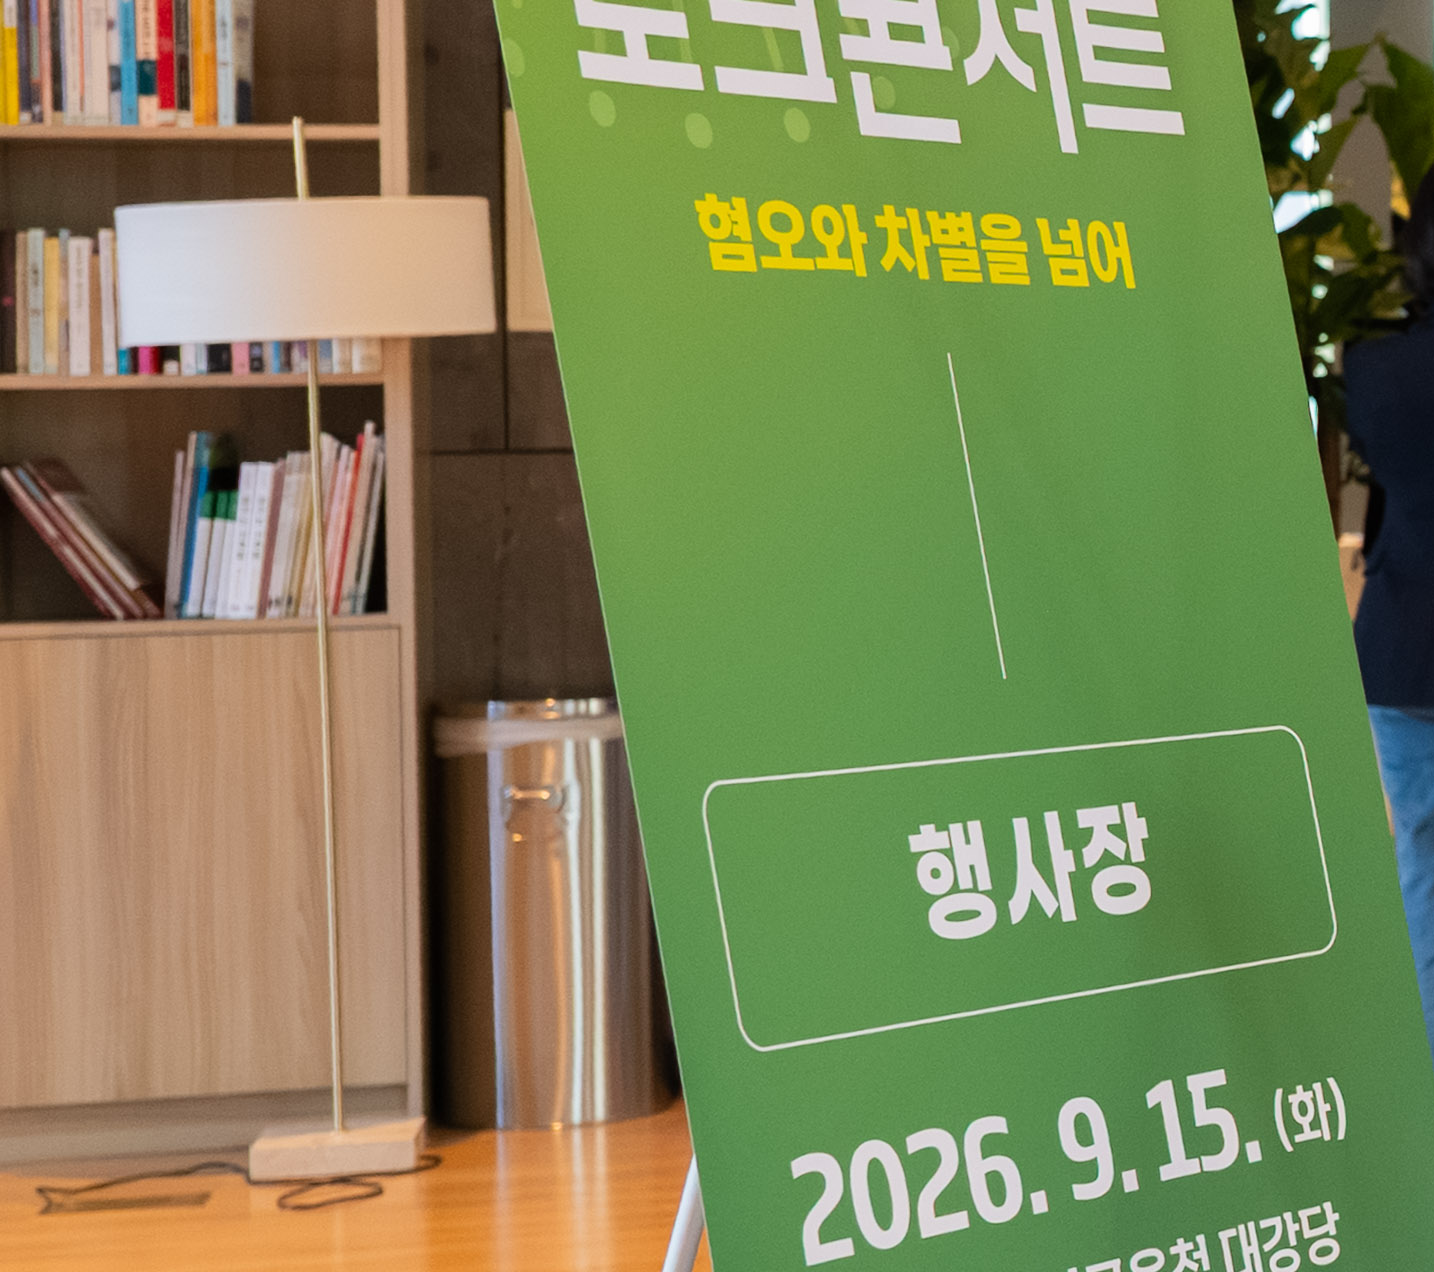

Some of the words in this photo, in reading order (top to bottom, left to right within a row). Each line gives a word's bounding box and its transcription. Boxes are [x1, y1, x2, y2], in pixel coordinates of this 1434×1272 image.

[694, 192, 869, 278] 혐오와
[874, 204, 1031, 286] 차별을
[1035, 217, 1137, 290] 넘어
[907, 801, 1152, 941] 행사장
[789, 1114, 1049, 1268] 2026.
[1274, 1076, 1347, 1153] (화)
